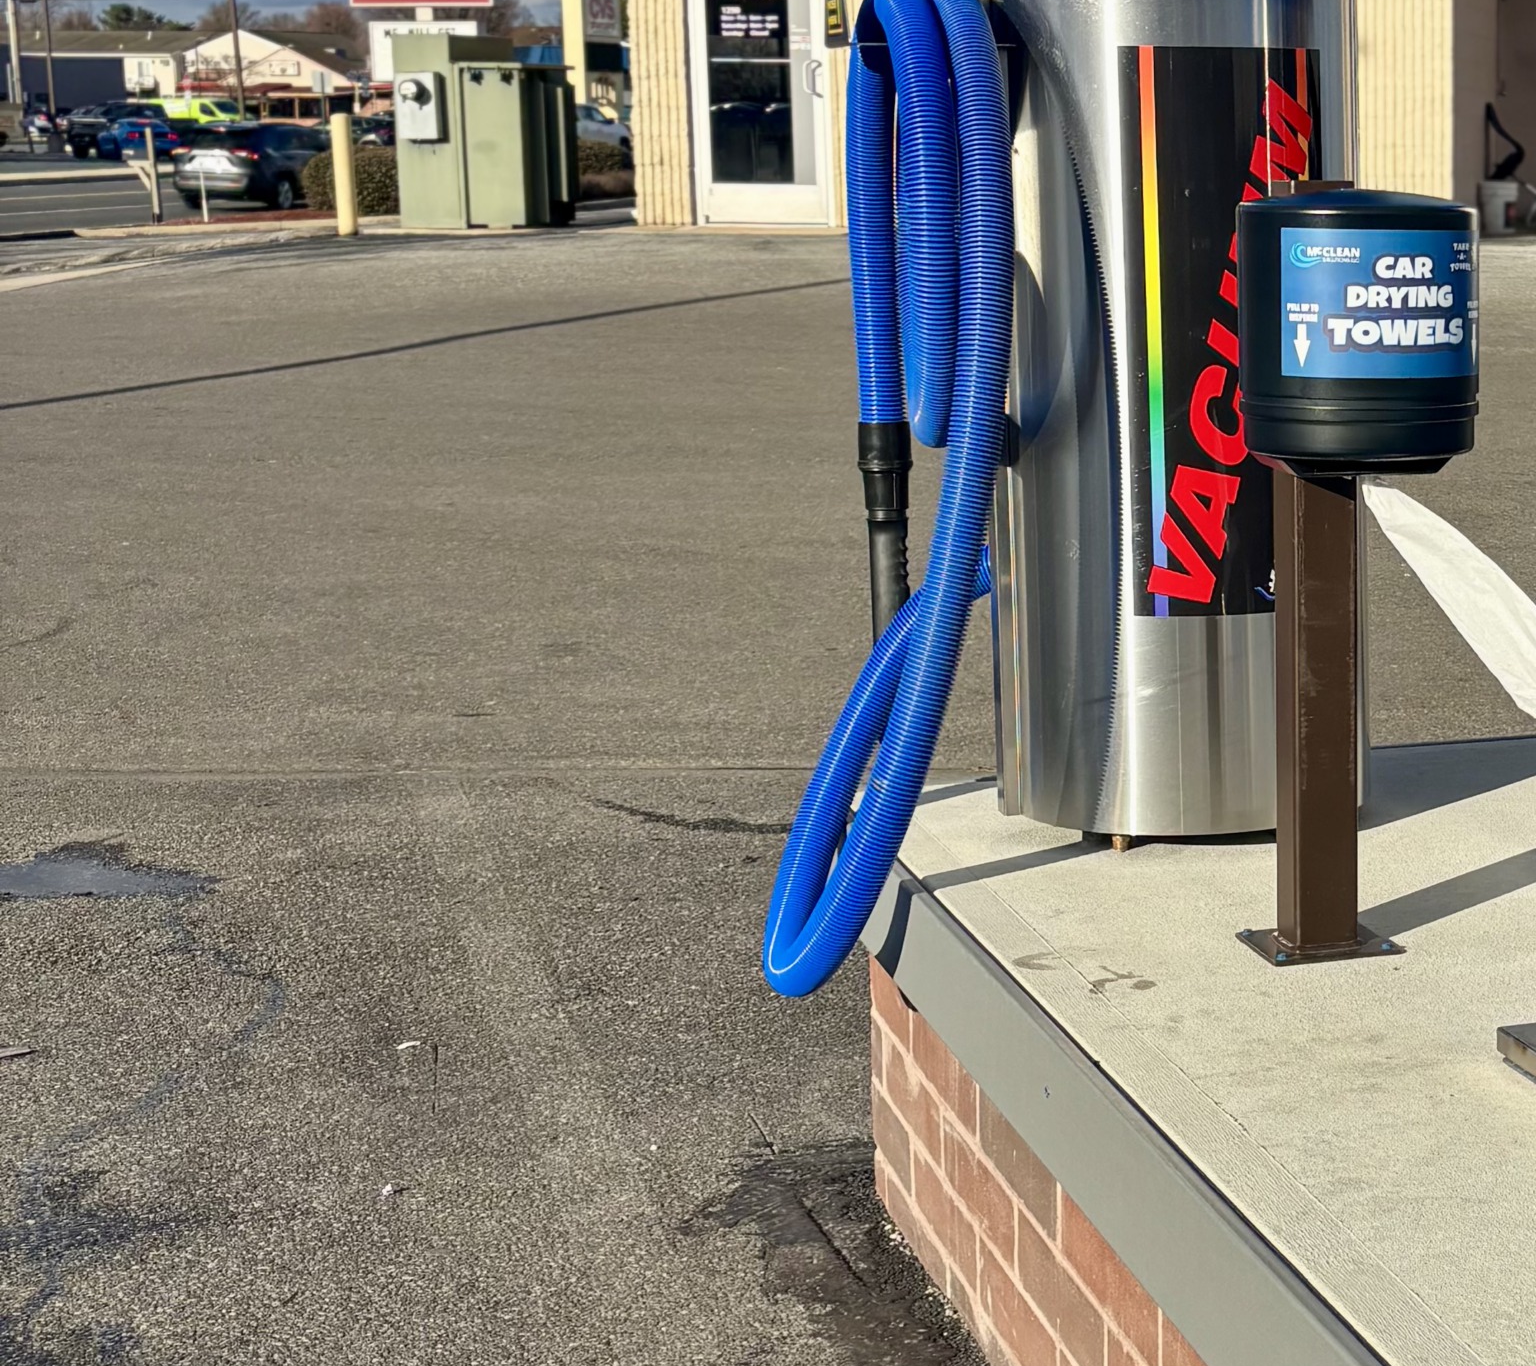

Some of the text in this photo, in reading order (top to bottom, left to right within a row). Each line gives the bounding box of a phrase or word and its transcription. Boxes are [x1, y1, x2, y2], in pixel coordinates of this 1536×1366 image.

[1375, 256, 1433, 280] CAR
[1346, 285, 1453, 309] DRYING
[1147, 78, 1313, 604] VACM
[1326, 317, 1464, 347] TOWELS
